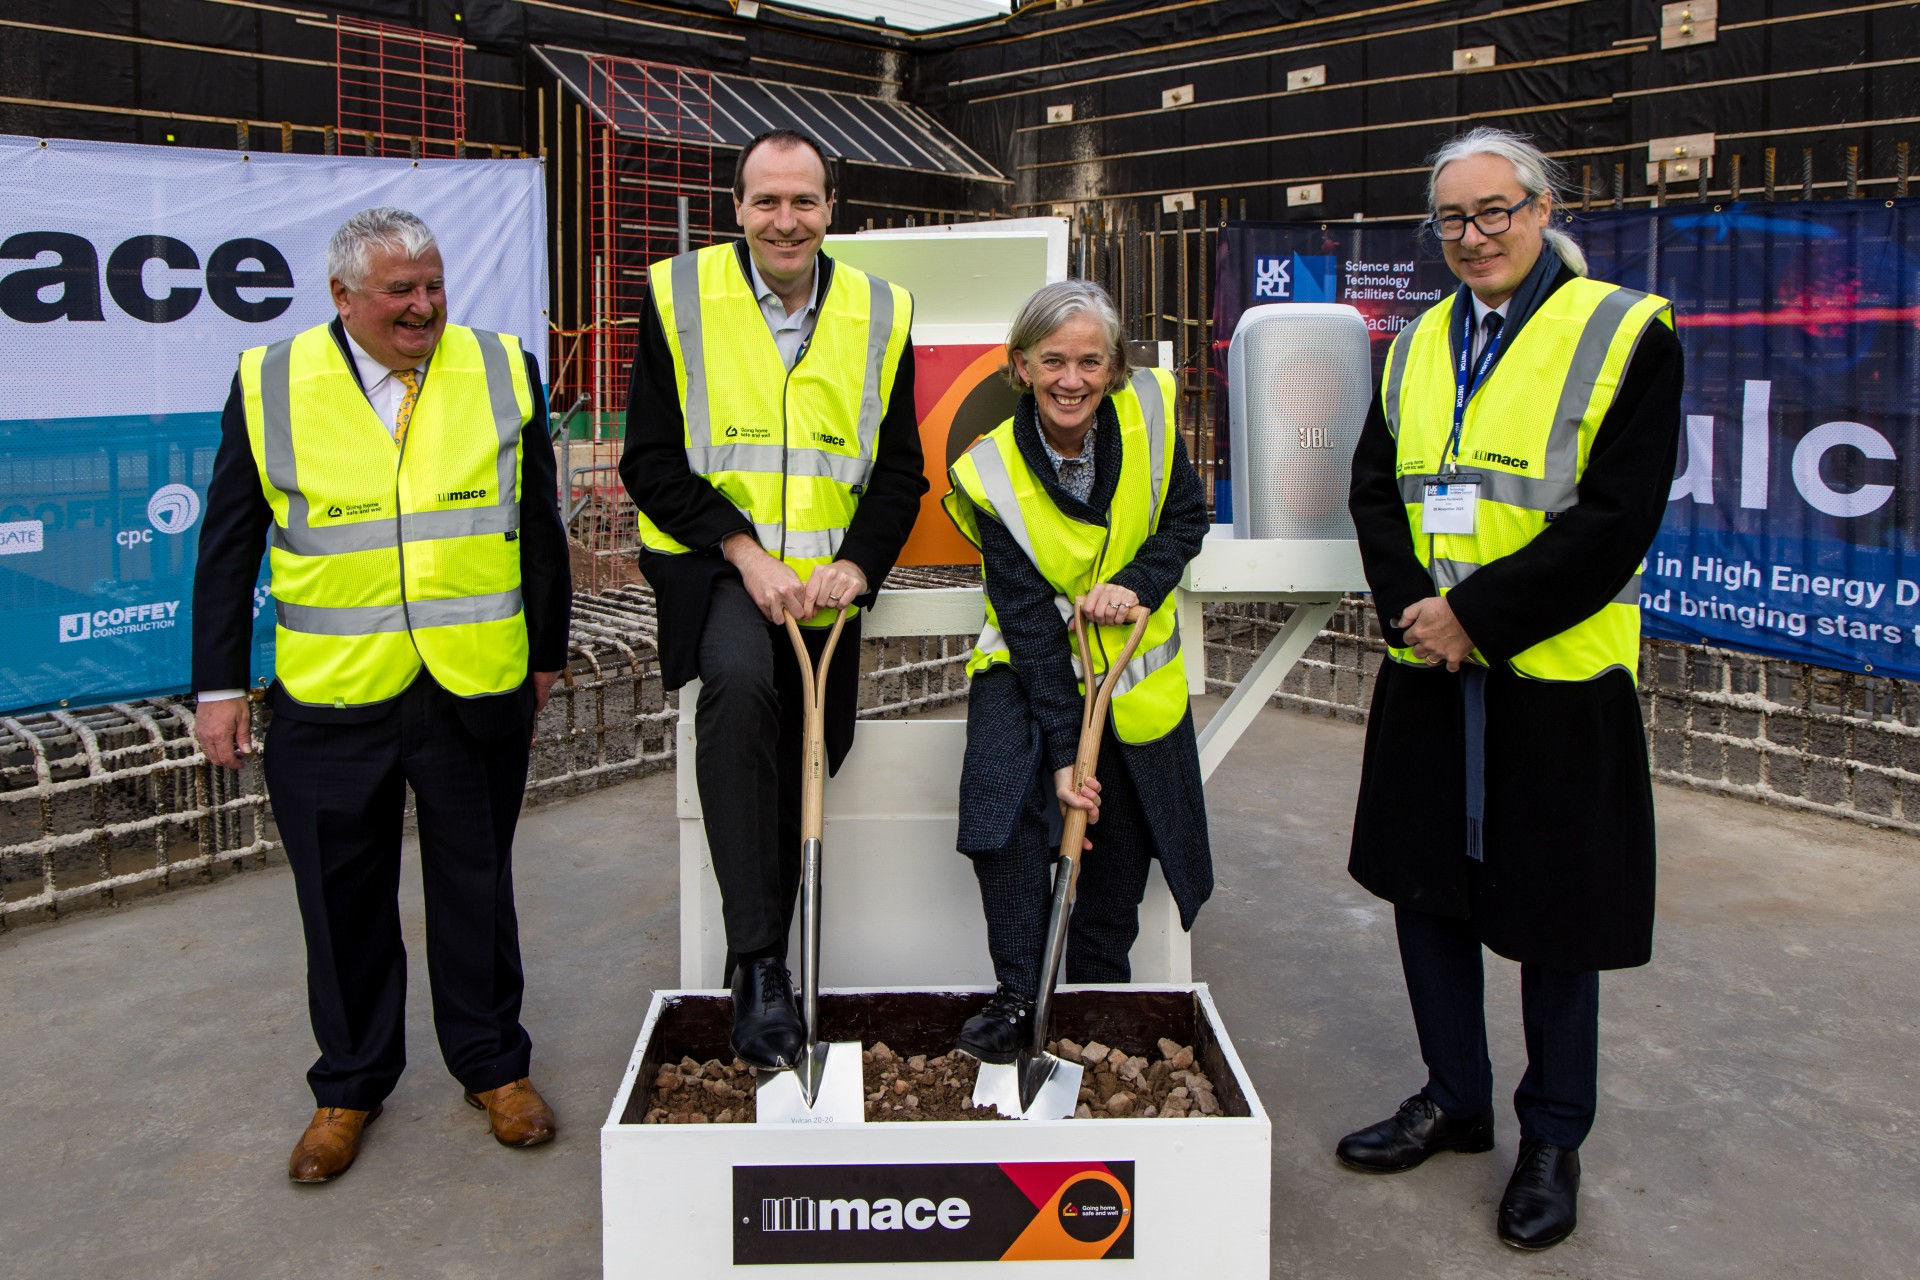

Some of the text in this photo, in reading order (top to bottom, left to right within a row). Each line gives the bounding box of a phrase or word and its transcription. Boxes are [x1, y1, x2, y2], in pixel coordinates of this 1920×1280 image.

[1344, 261, 1414, 272] Science and
[1345, 275, 1410, 288] Technology
[1344, 289, 1442, 301] Facilities Council
[1479, 352, 1494, 375] VISITOR
[1300, 427, 1334, 449] JBL
[1487, 451, 1529, 470] mace
[450, 489, 486, 501] mace
[116, 529, 153, 549] cpc
[1656, 551, 1682, 578] in
[1691, 556, 1761, 591] High
[1771, 565, 1886, 609] Energy
[92, 600, 180, 628] COFFEY
[1680, 591, 1806, 637] bringing
[1817, 615, 1902, 644] stars
[92, 619, 175, 638] CONSTRUCTION
[813, 1116, 834, 1124] 20-20
[818, 1197, 971, 1232] mace
